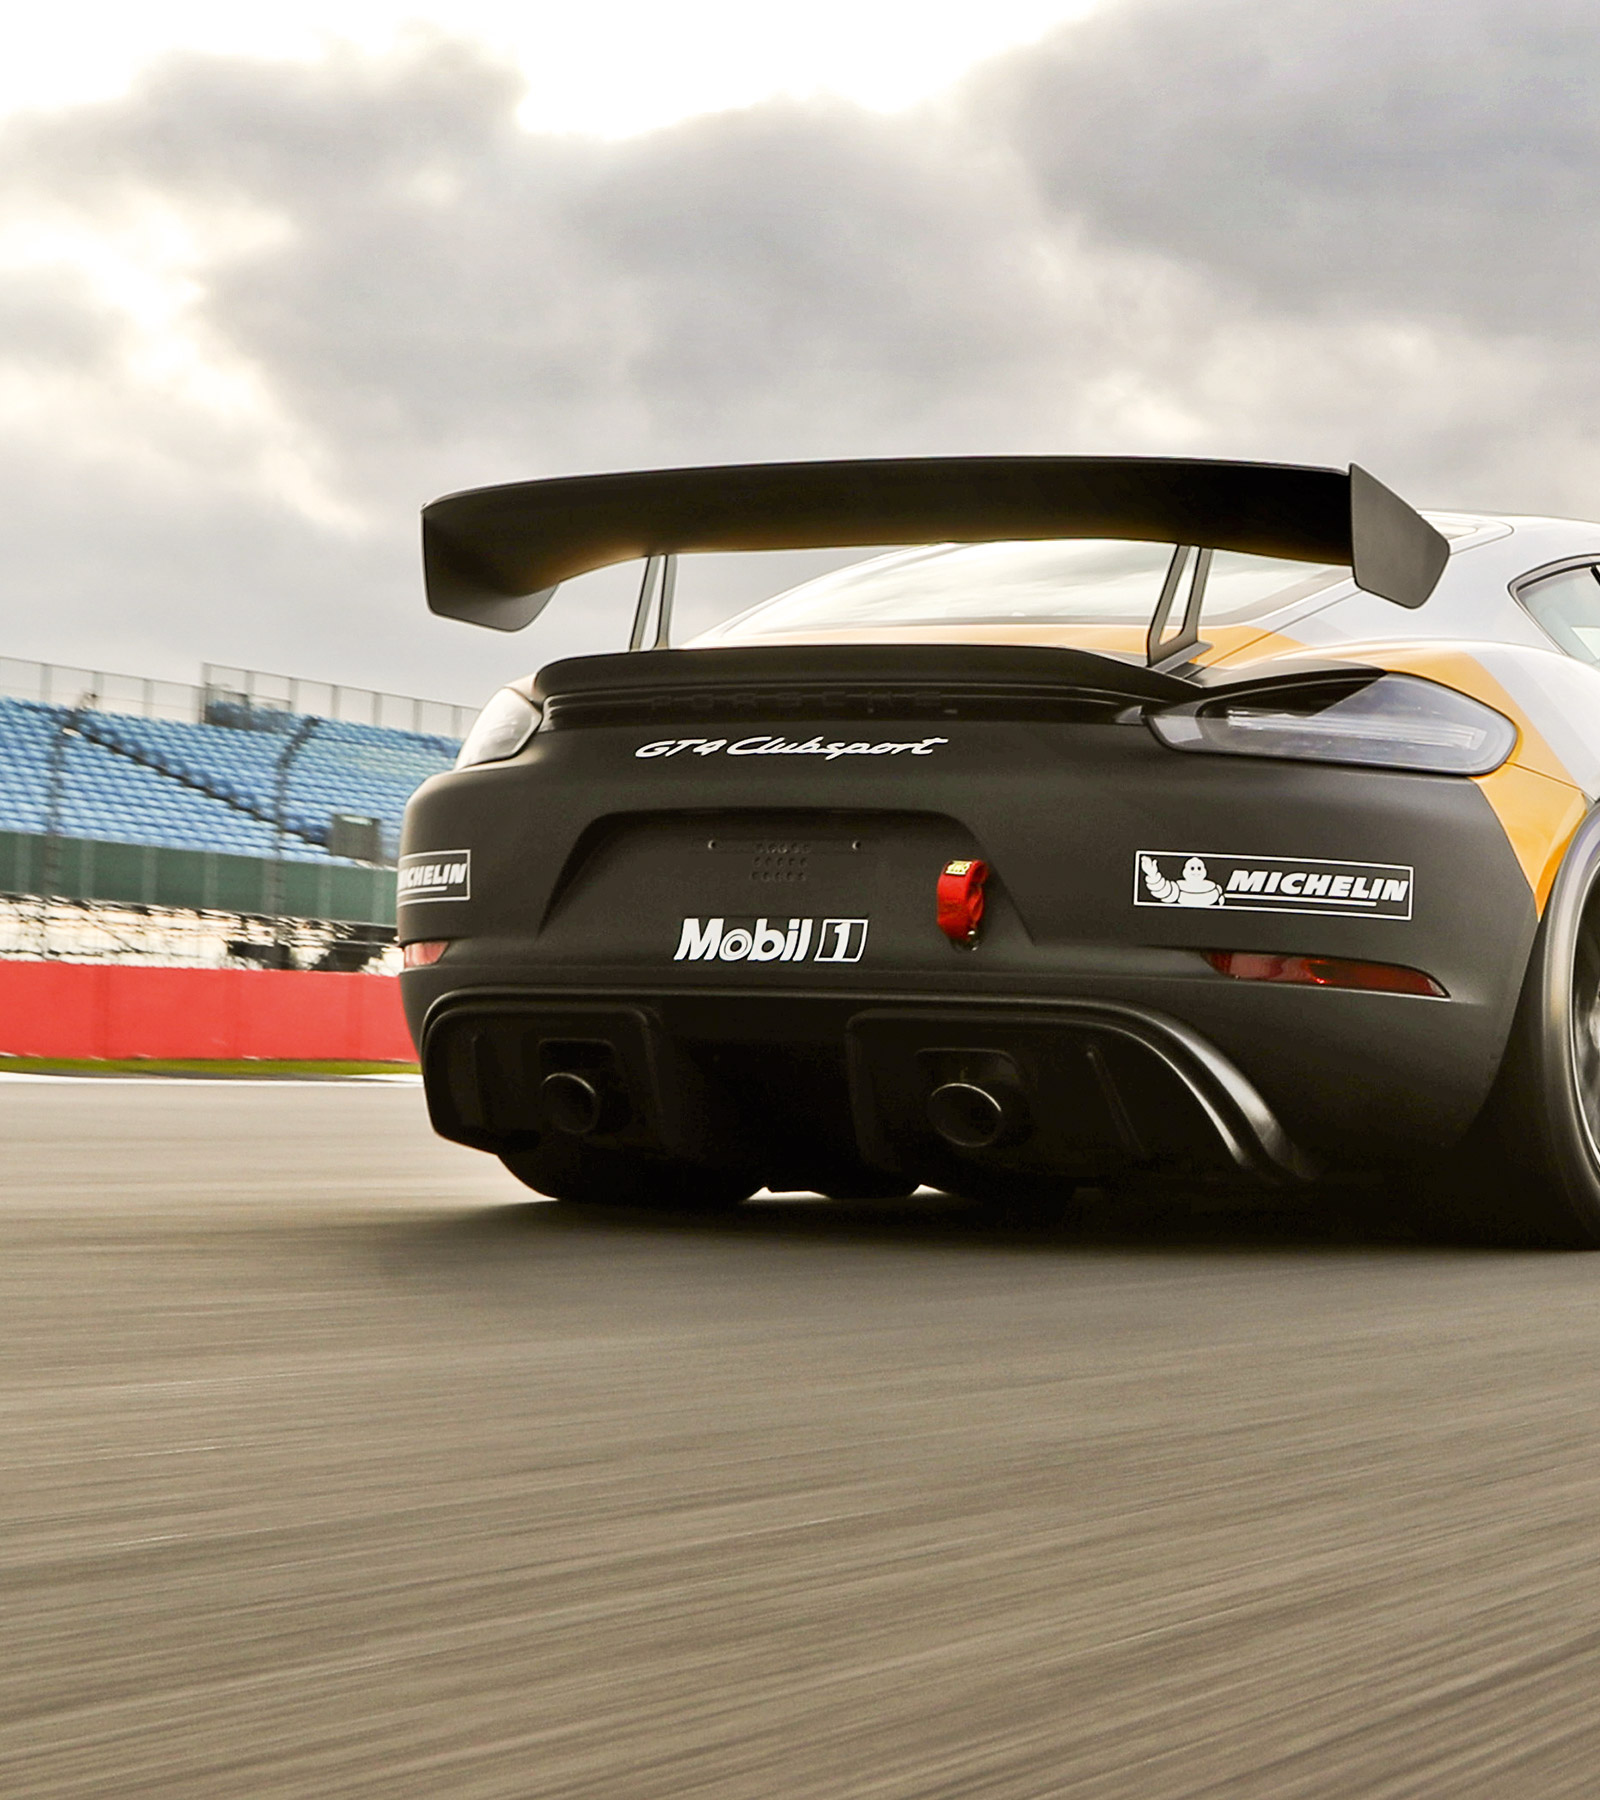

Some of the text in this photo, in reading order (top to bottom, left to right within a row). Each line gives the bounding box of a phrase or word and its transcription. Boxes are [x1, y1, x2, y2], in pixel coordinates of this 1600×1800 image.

[635, 736, 948, 760] GT4 Clubsport
[399, 863, 467, 890] ICHELIN
[1226, 869, 1409, 902] MICHELIN
[673, 918, 813, 961] Mobil
